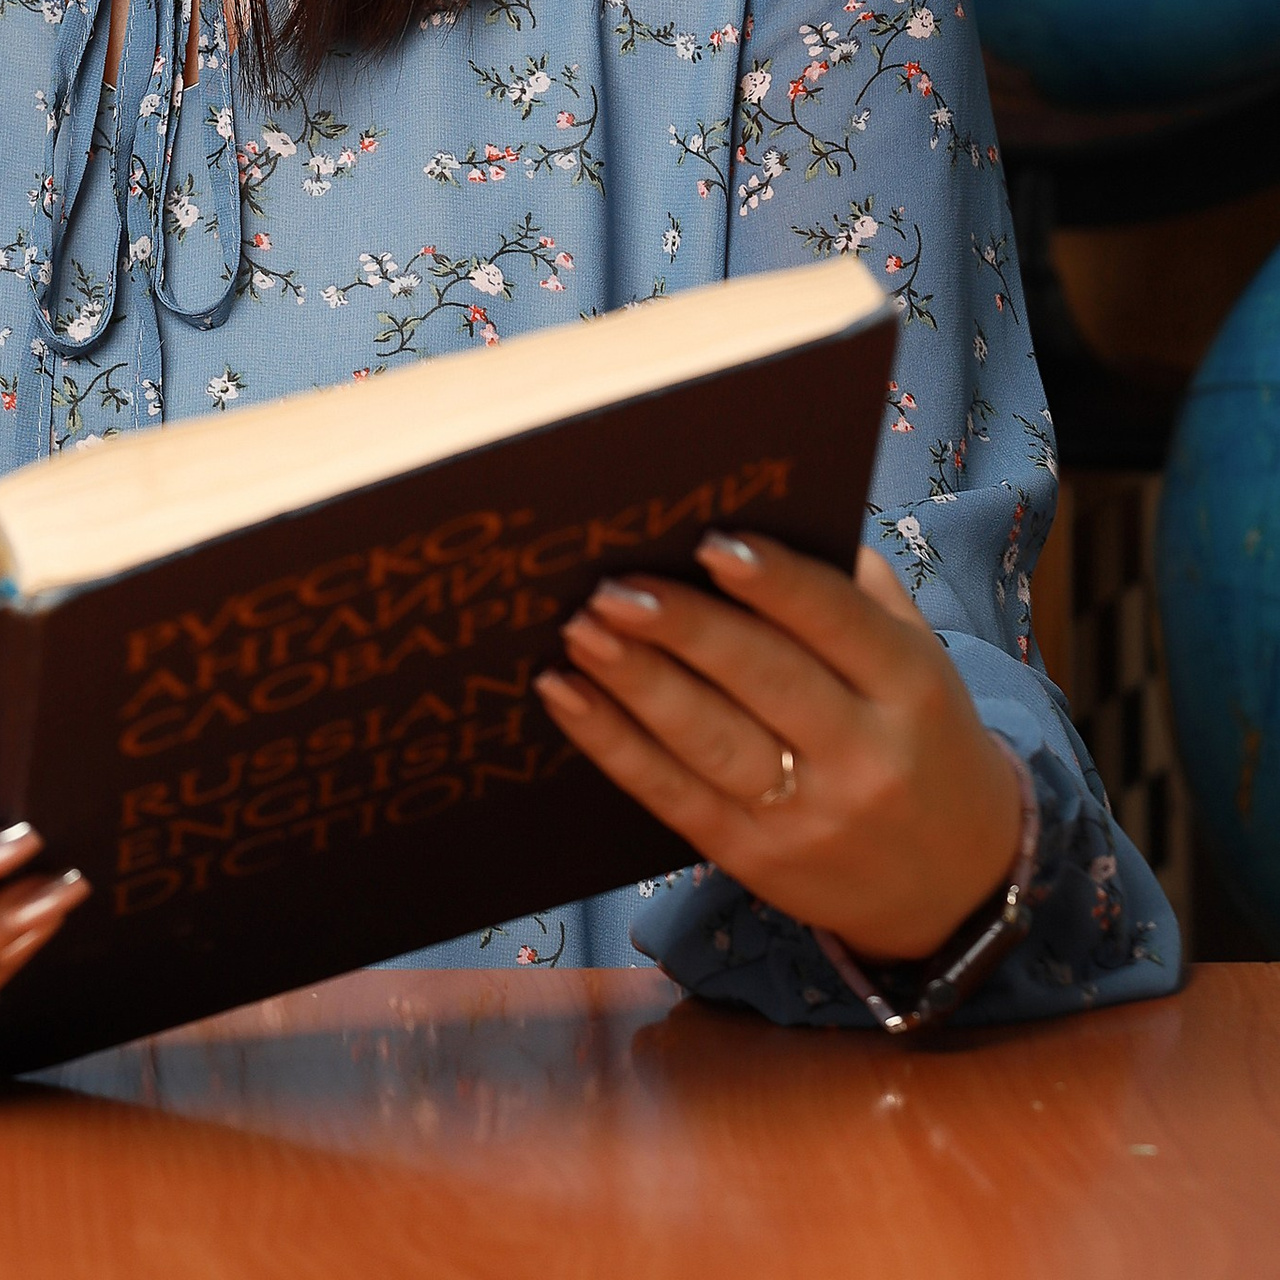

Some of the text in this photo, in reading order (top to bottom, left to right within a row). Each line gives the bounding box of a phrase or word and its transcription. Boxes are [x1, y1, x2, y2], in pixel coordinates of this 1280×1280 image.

[121, 456, 796, 720] АНГЛИЙСКИЙ
[126, 507, 535, 673] РУССКО-
[118, 595, 561, 759] СЛОВАРЬ
[121, 656, 532, 829] RUSSIAN
[116, 704, 526, 875] ENGLISH
